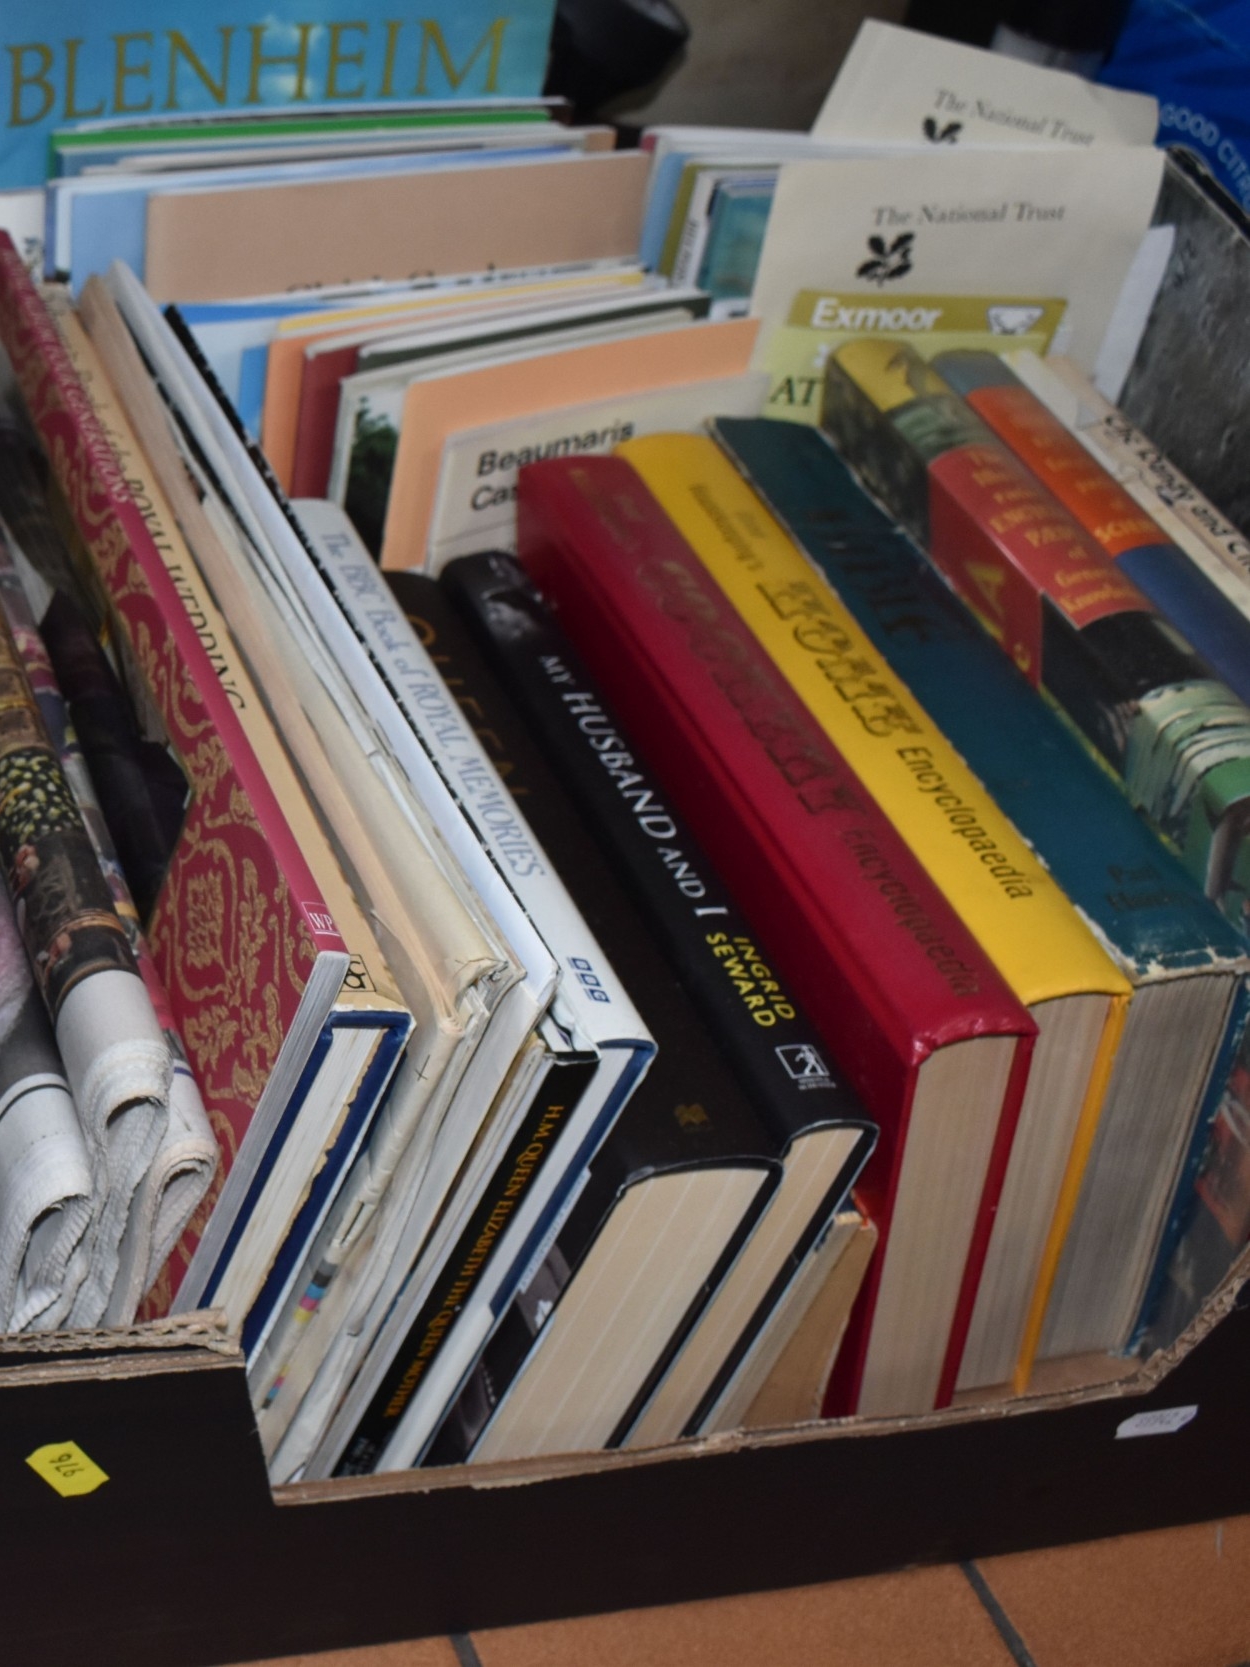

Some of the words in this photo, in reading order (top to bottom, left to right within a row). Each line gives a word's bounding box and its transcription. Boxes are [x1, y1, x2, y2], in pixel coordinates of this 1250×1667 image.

[4, 15, 514, 129] BLENHEIM
[933, 88, 966, 112] The
[969, 99, 1048, 138] National
[1049, 119, 1096, 147] Trust
[873, 206, 913, 227] The
[917, 203, 1007, 225] National
[1014, 200, 1067, 223] Trust
[810, 296, 943, 330] Exmoor
[477, 419, 636, 478] Beaumaris
[396, 651, 432, 682] of
[407, 681, 469, 758] ROYAL
[447, 755, 548, 880] MEMORIES
[538, 654, 577, 686] MY
[561, 691, 678, 841] HUSBAND
[657, 845, 707, 899] AND
[693, 905, 730, 918] I
[896, 743, 1036, 902] Encyclopaedia
[705, 931, 777, 1028] SEWARD
[732, 935, 797, 1021] INGRID
[503, 1142, 545, 1197] QUEEN
[458, 1199, 516, 1278] ELIZABETH
[48, 1452, 86, 1478] 976
